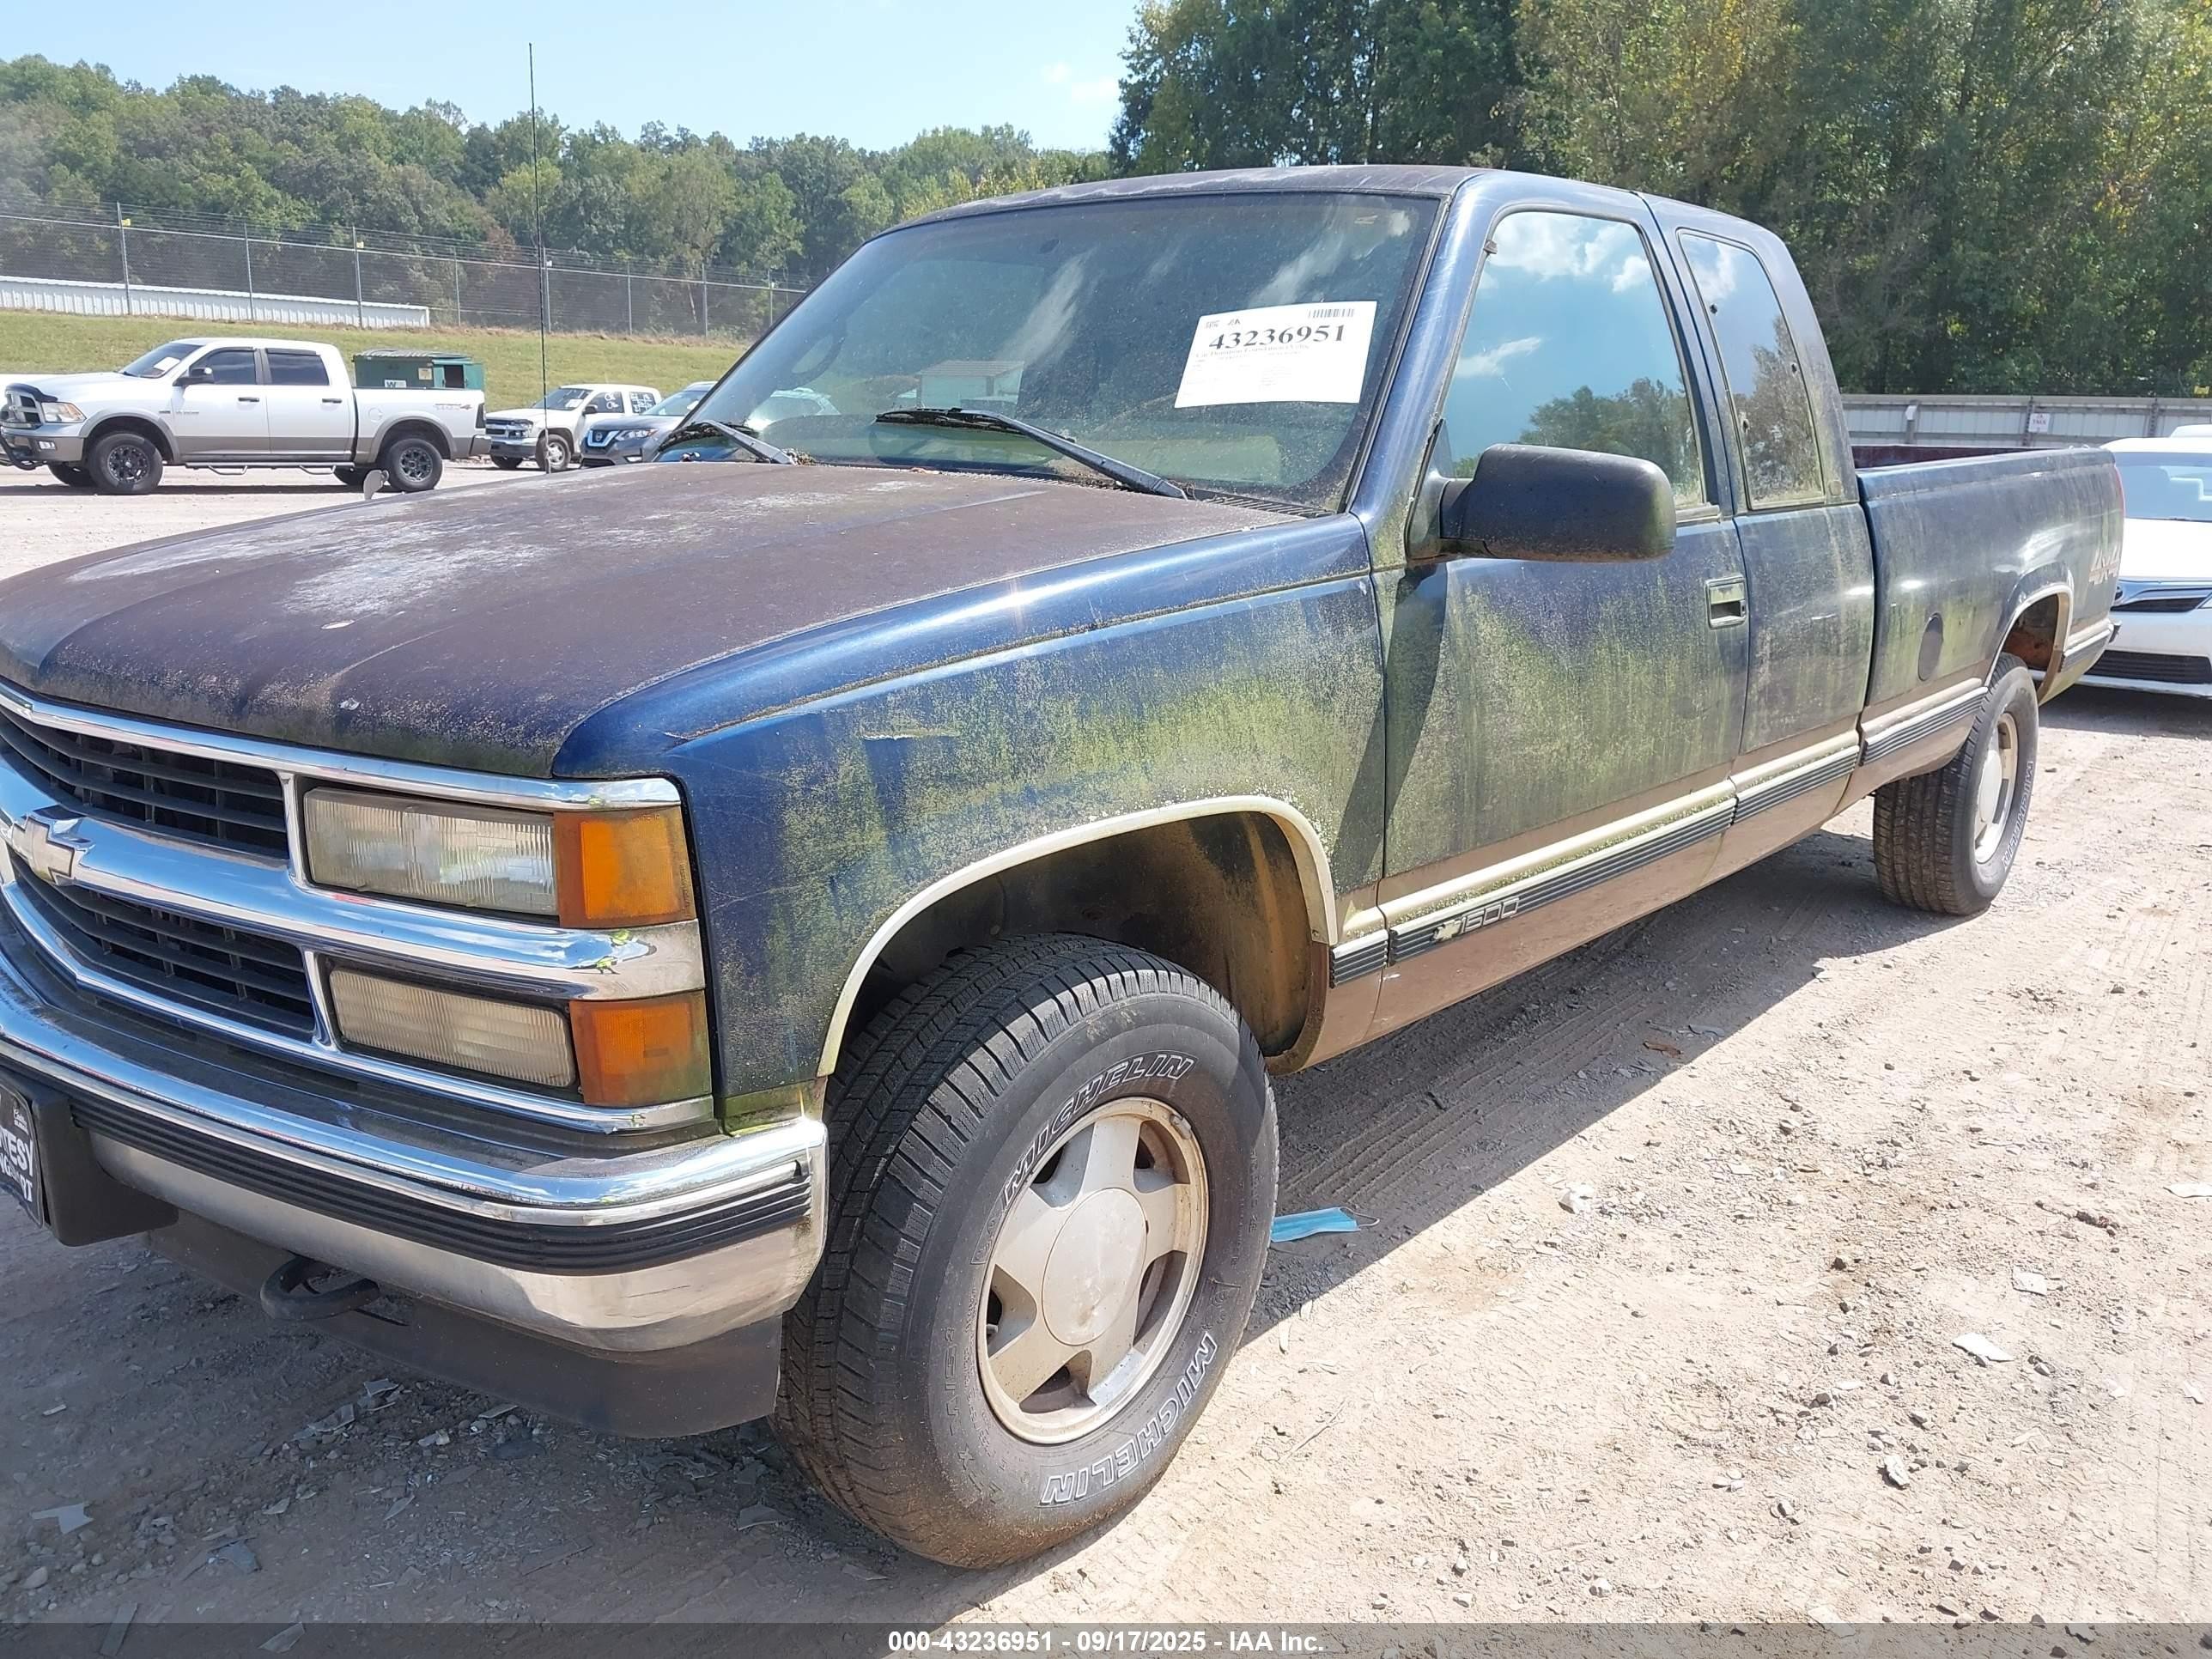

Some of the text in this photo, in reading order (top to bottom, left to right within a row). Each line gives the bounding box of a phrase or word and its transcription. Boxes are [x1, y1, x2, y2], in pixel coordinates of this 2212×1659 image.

[1208, 325, 1346, 349] 43236951
[1461, 896, 1520, 934] 1500
[0, 1126, 33, 1177] TESY
[1004, 1053, 1195, 1206] MICHELIN
[1041, 1331, 1218, 1503] MICHELIN
